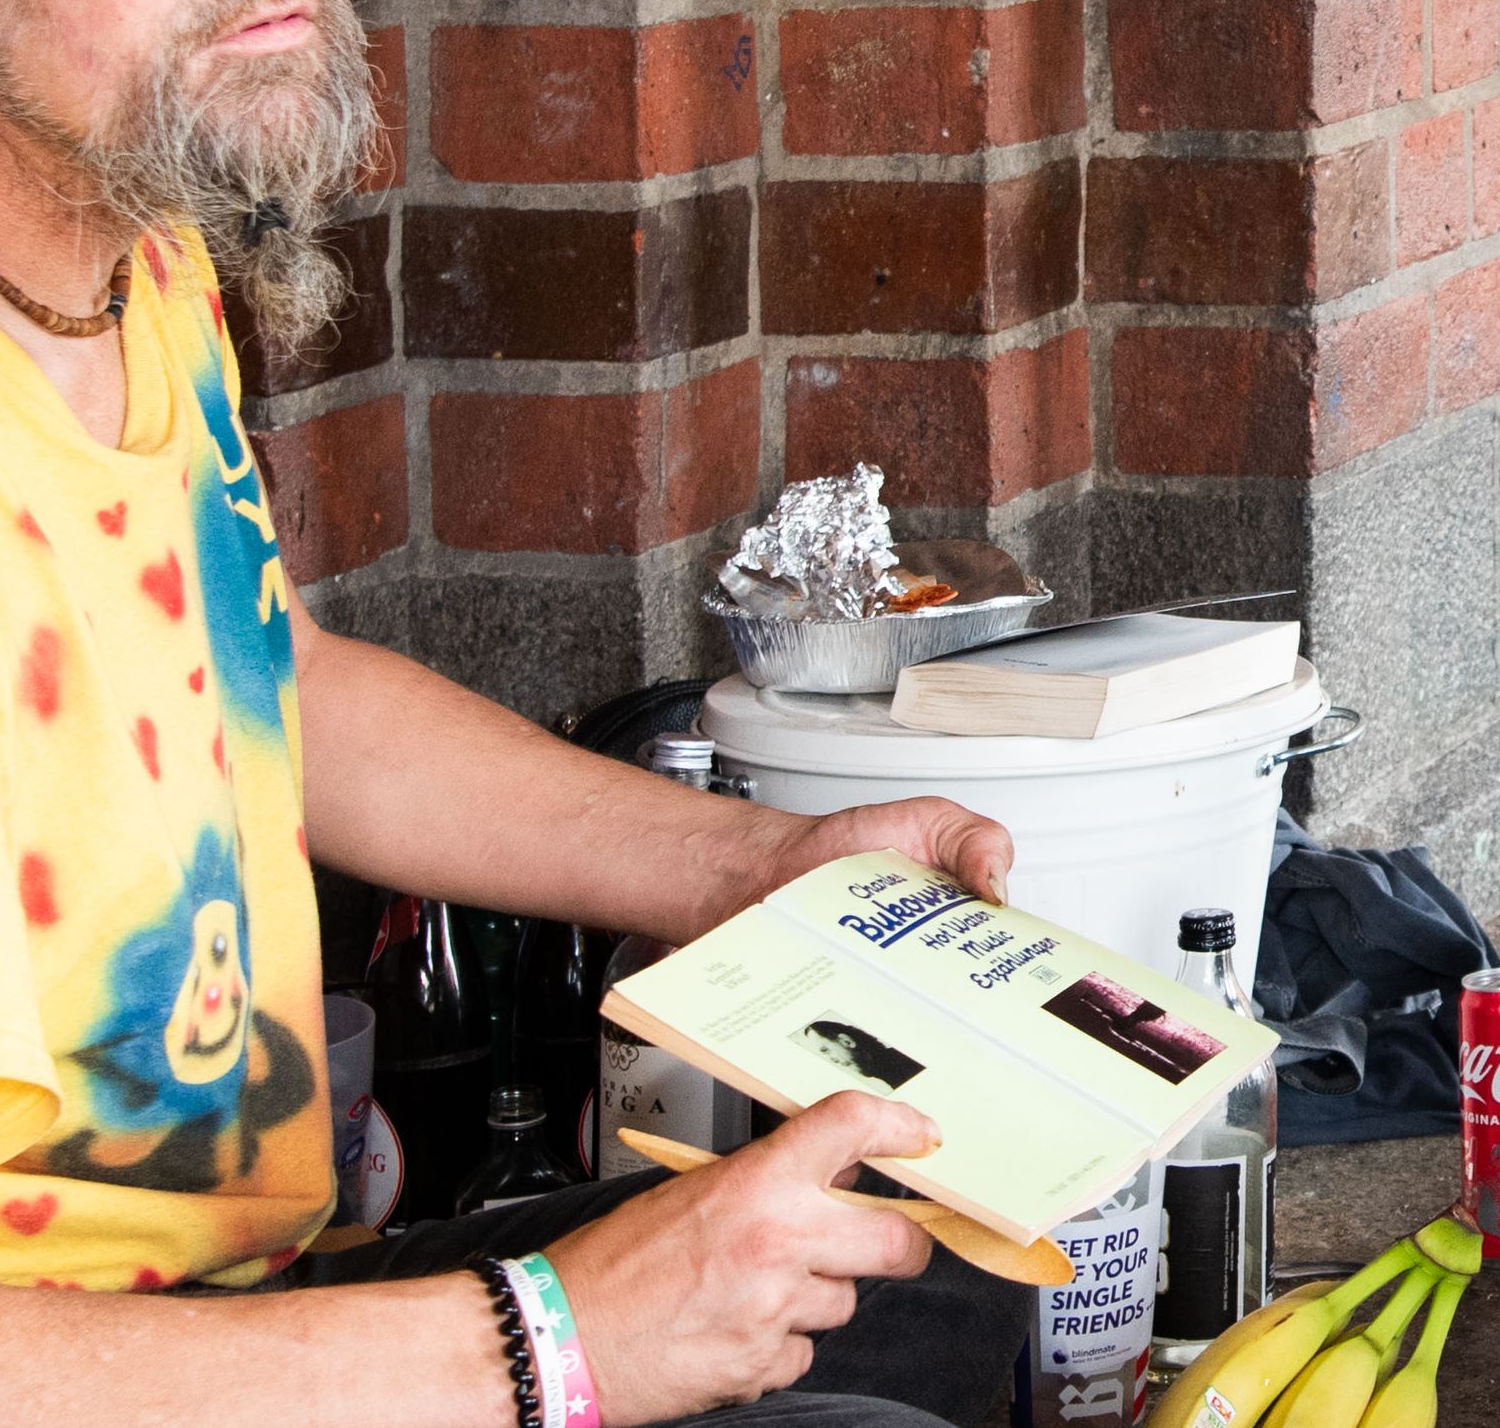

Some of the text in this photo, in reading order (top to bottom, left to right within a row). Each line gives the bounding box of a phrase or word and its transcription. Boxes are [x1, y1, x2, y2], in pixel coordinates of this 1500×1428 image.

[848, 872, 908, 900] Charles
[919, 909, 997, 951] Hot Water
[957, 929, 1015, 960] Music
[969, 936, 1061, 990] Erzählungen
[602, 1078, 642, 1095] GRAN
[604, 1091, 666, 1114] EGA
[1103, 1227, 1139, 1254] RID
[1091, 1247, 1148, 1281] YOUR
[1051, 1279, 1133, 1311] SINGLE
[1072, 1343, 1116, 1358] blindmate
